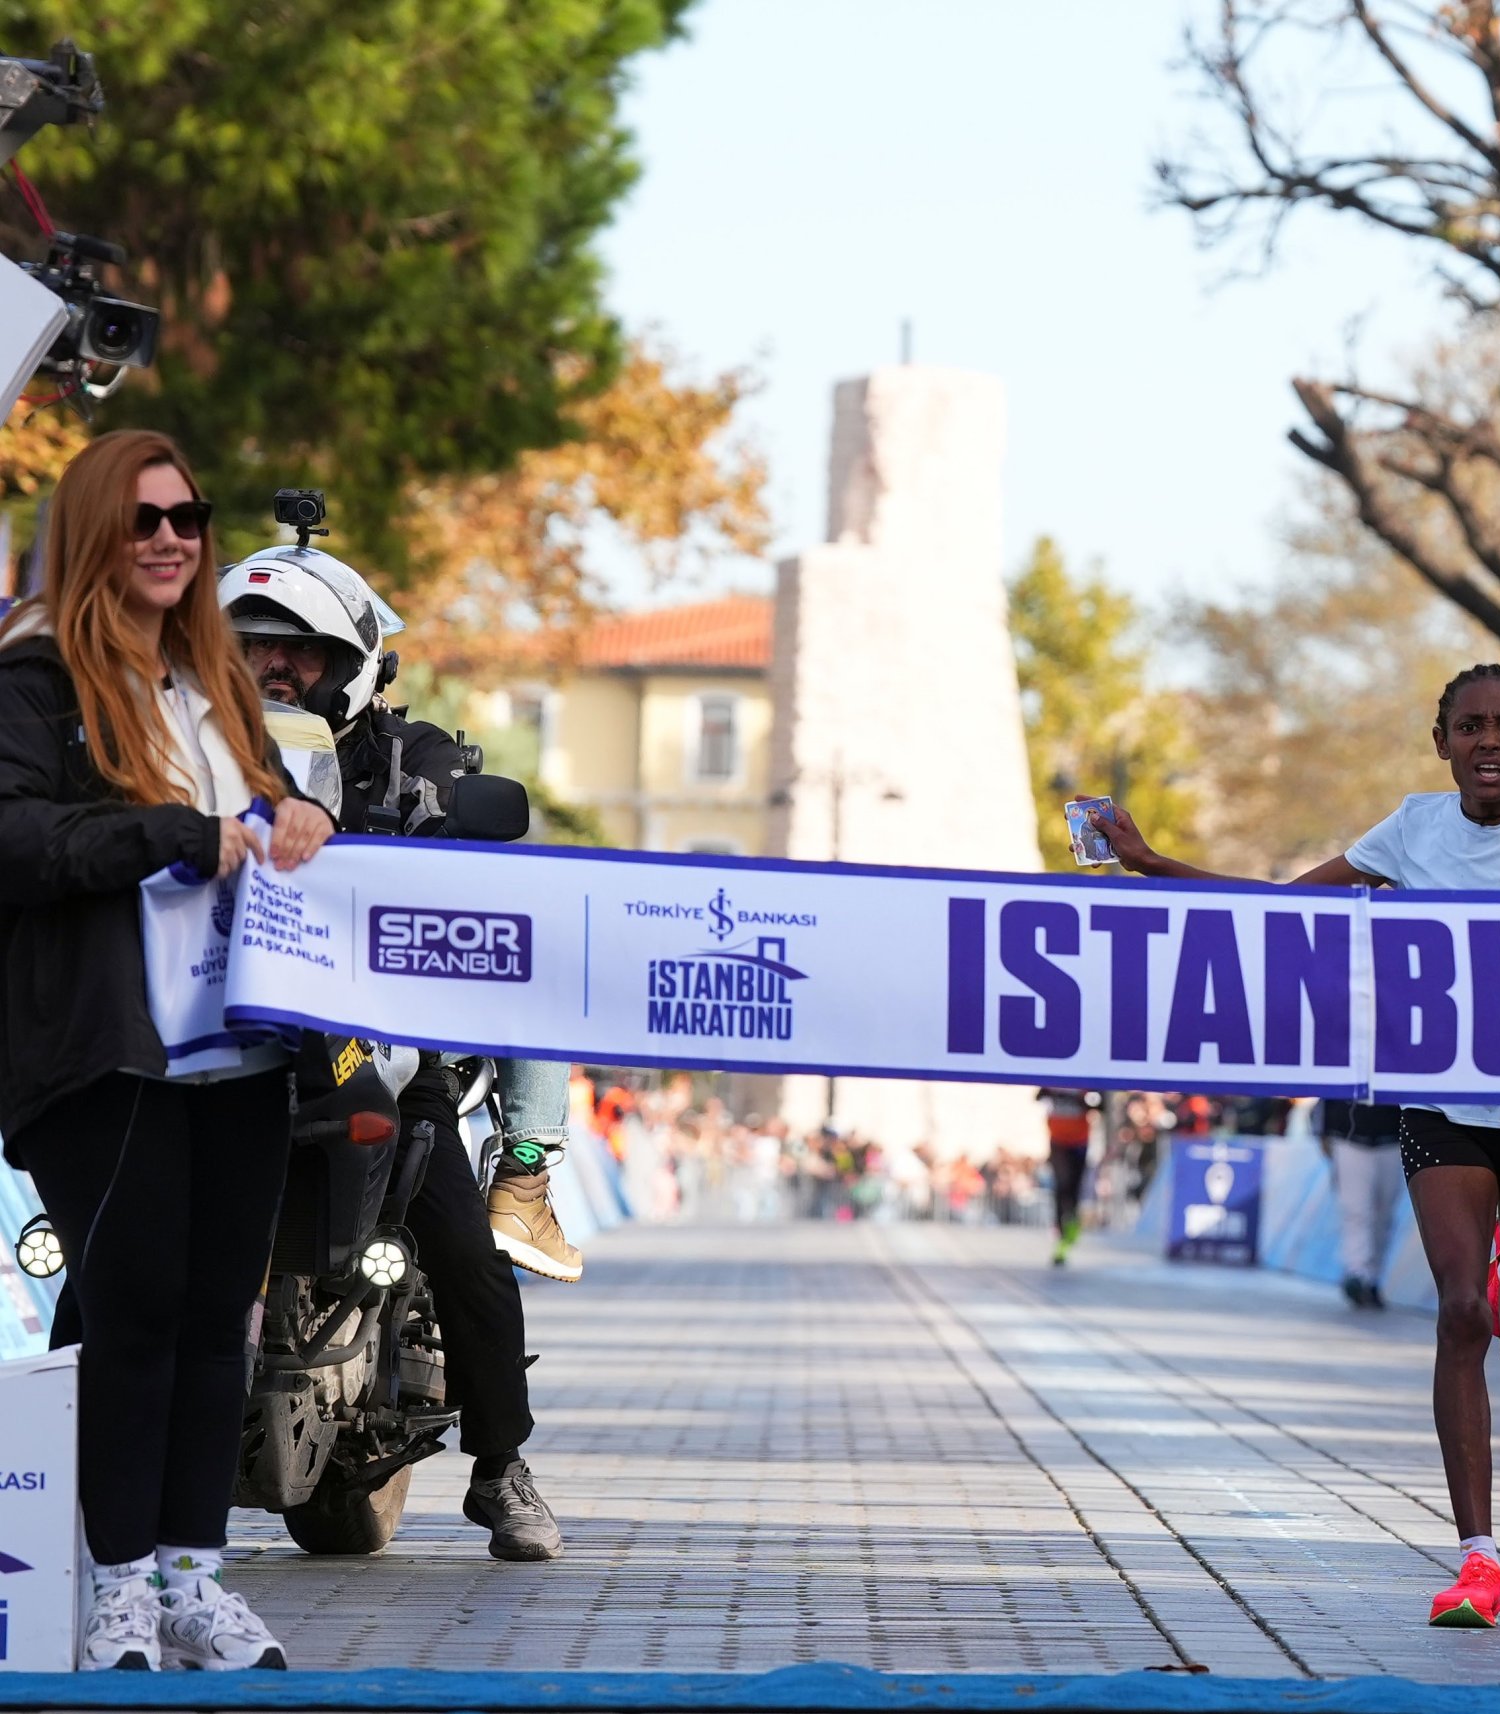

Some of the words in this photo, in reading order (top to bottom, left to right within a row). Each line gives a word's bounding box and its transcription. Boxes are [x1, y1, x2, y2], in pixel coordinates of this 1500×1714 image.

[244, 918, 301, 943] DAİRESİ
[246, 901, 330, 938] HİZMETLERİ
[624, 900, 704, 920] TÜRKİYE
[737, 910, 817, 927] BANKASI
[378, 913, 521, 953] SPOR
[242, 934, 335, 969] BAŞKANLIĞI
[647, 1000, 792, 1041] MARATONU
[0, 1471, 45, 1490] ASI
